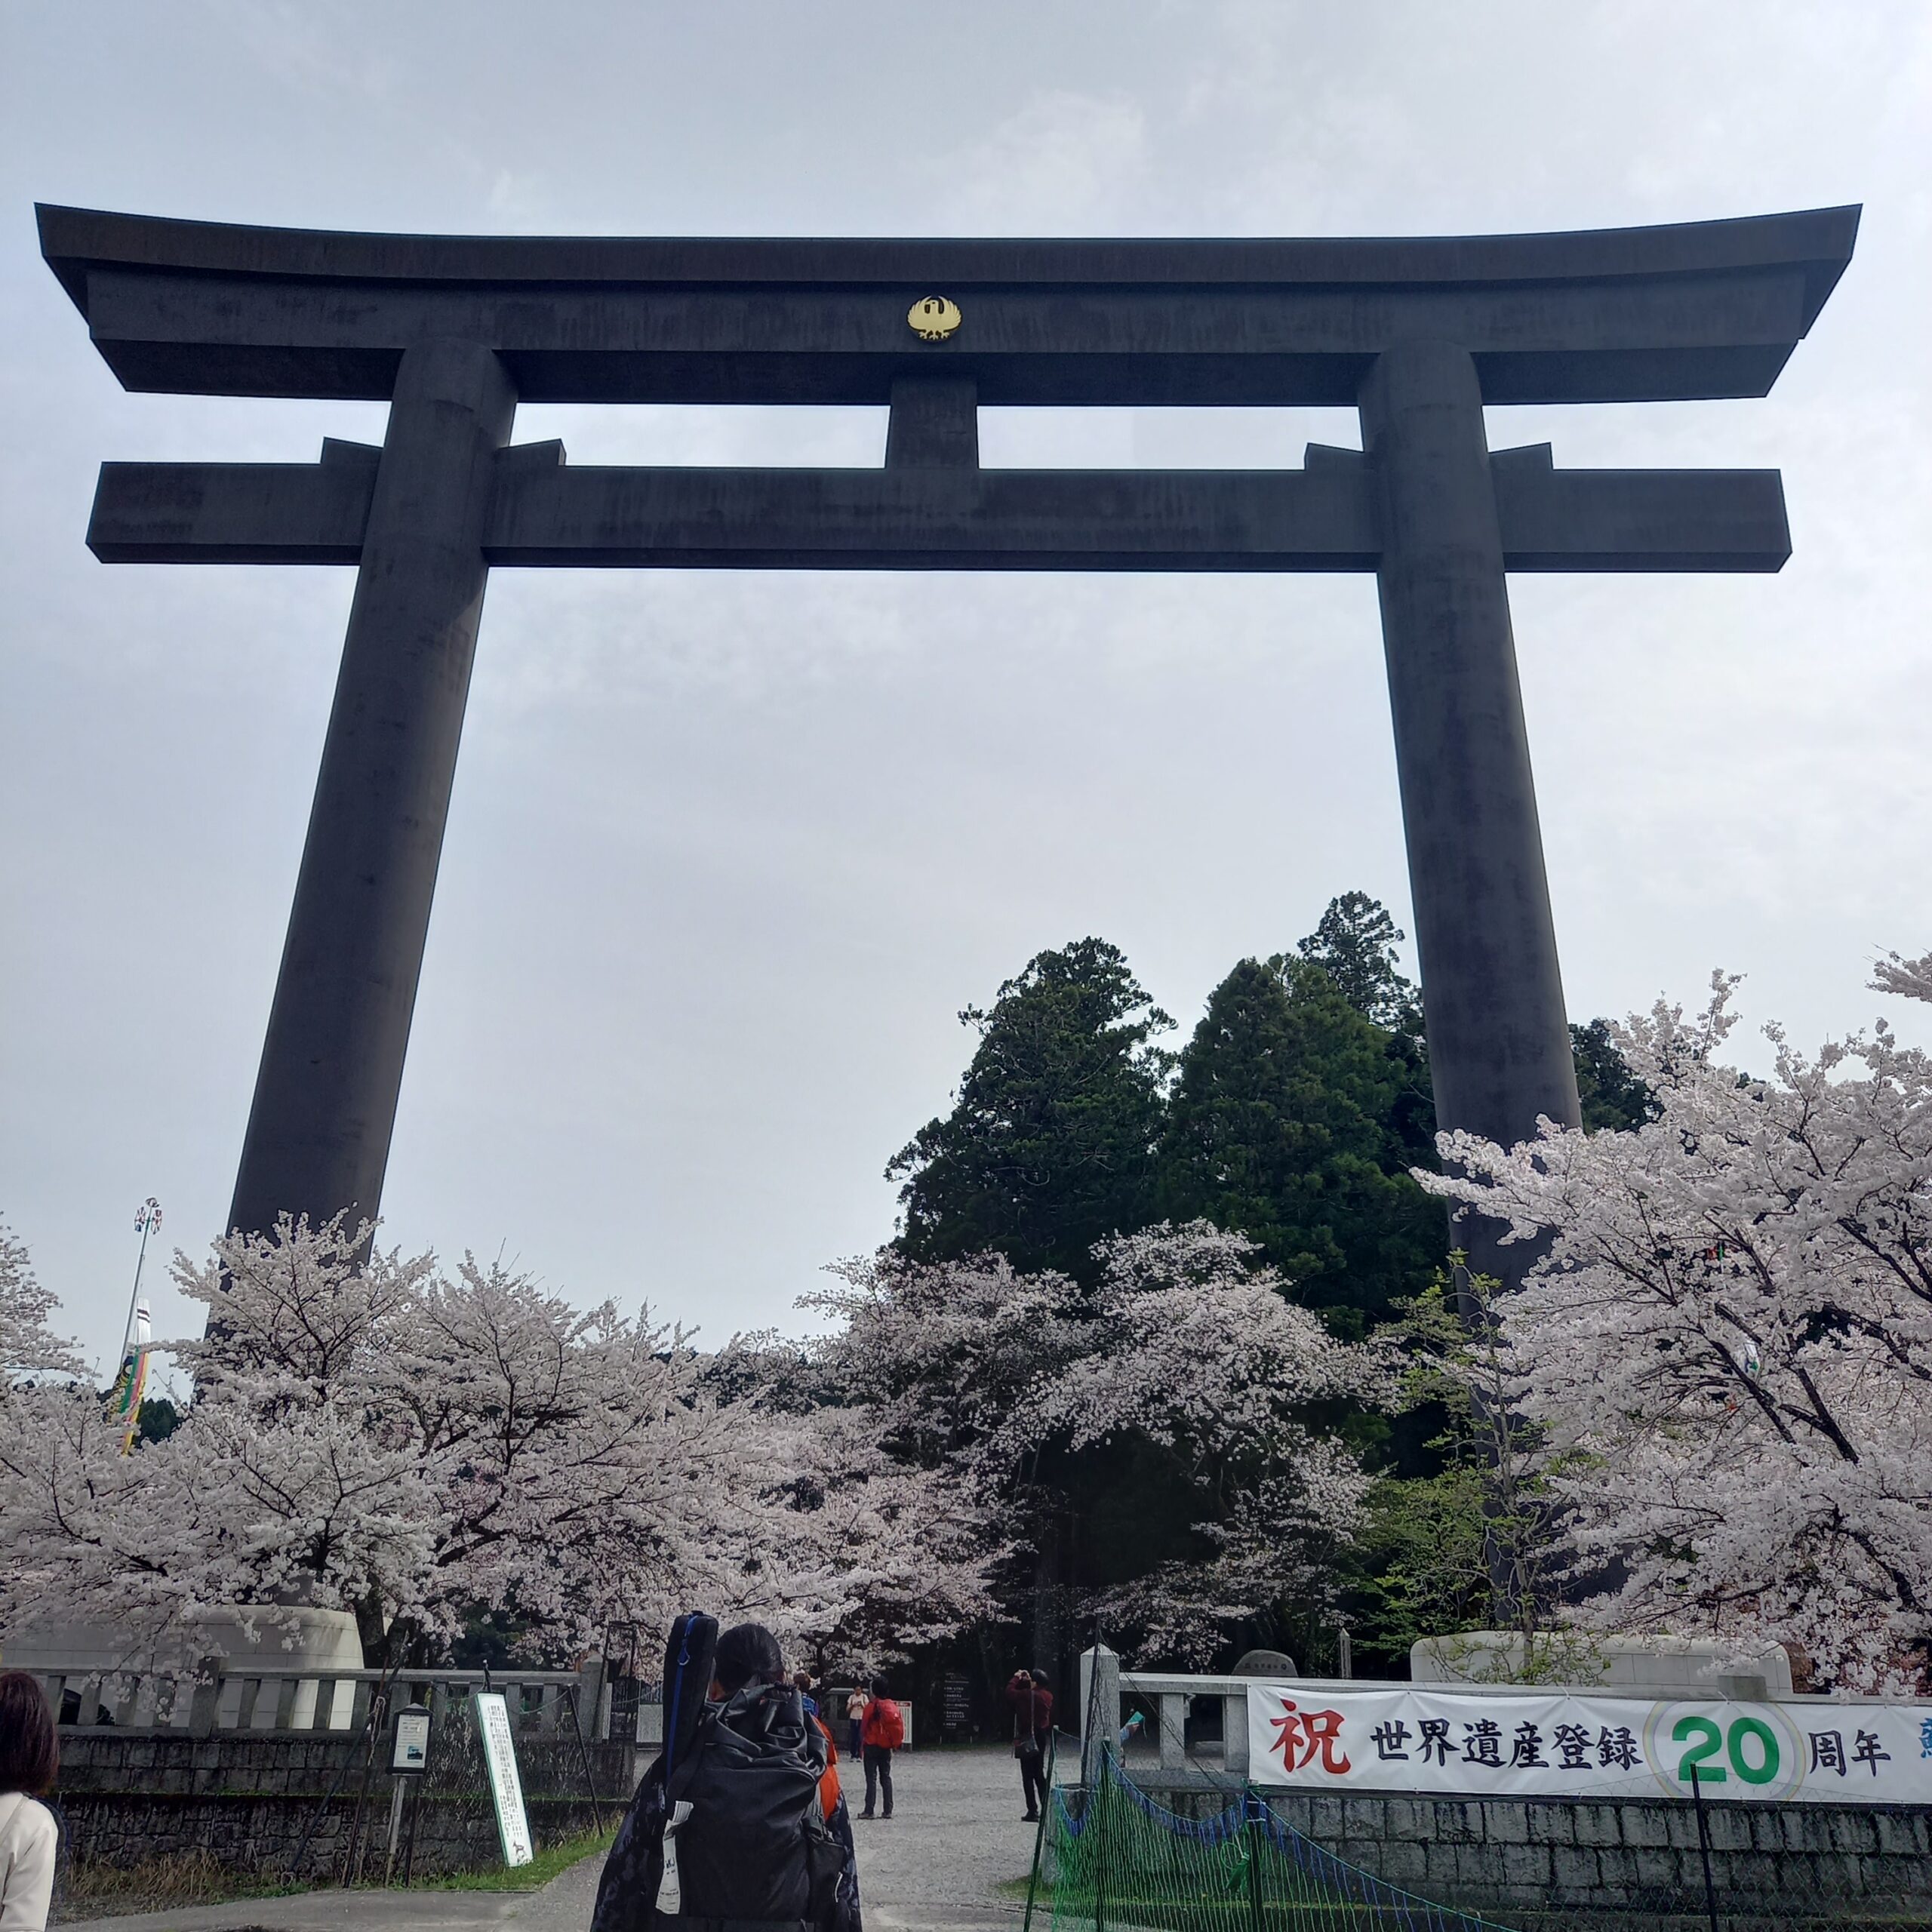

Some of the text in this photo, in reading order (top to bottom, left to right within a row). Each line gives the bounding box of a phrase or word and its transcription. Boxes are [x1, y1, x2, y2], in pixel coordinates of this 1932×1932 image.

[1269, 1699, 1351, 1774] 祝
[1370, 1718, 1644, 1771] 世界遺産登録
[1672, 1716, 1780, 1784] 20
[1808, 1730, 1891, 1777] 周年
